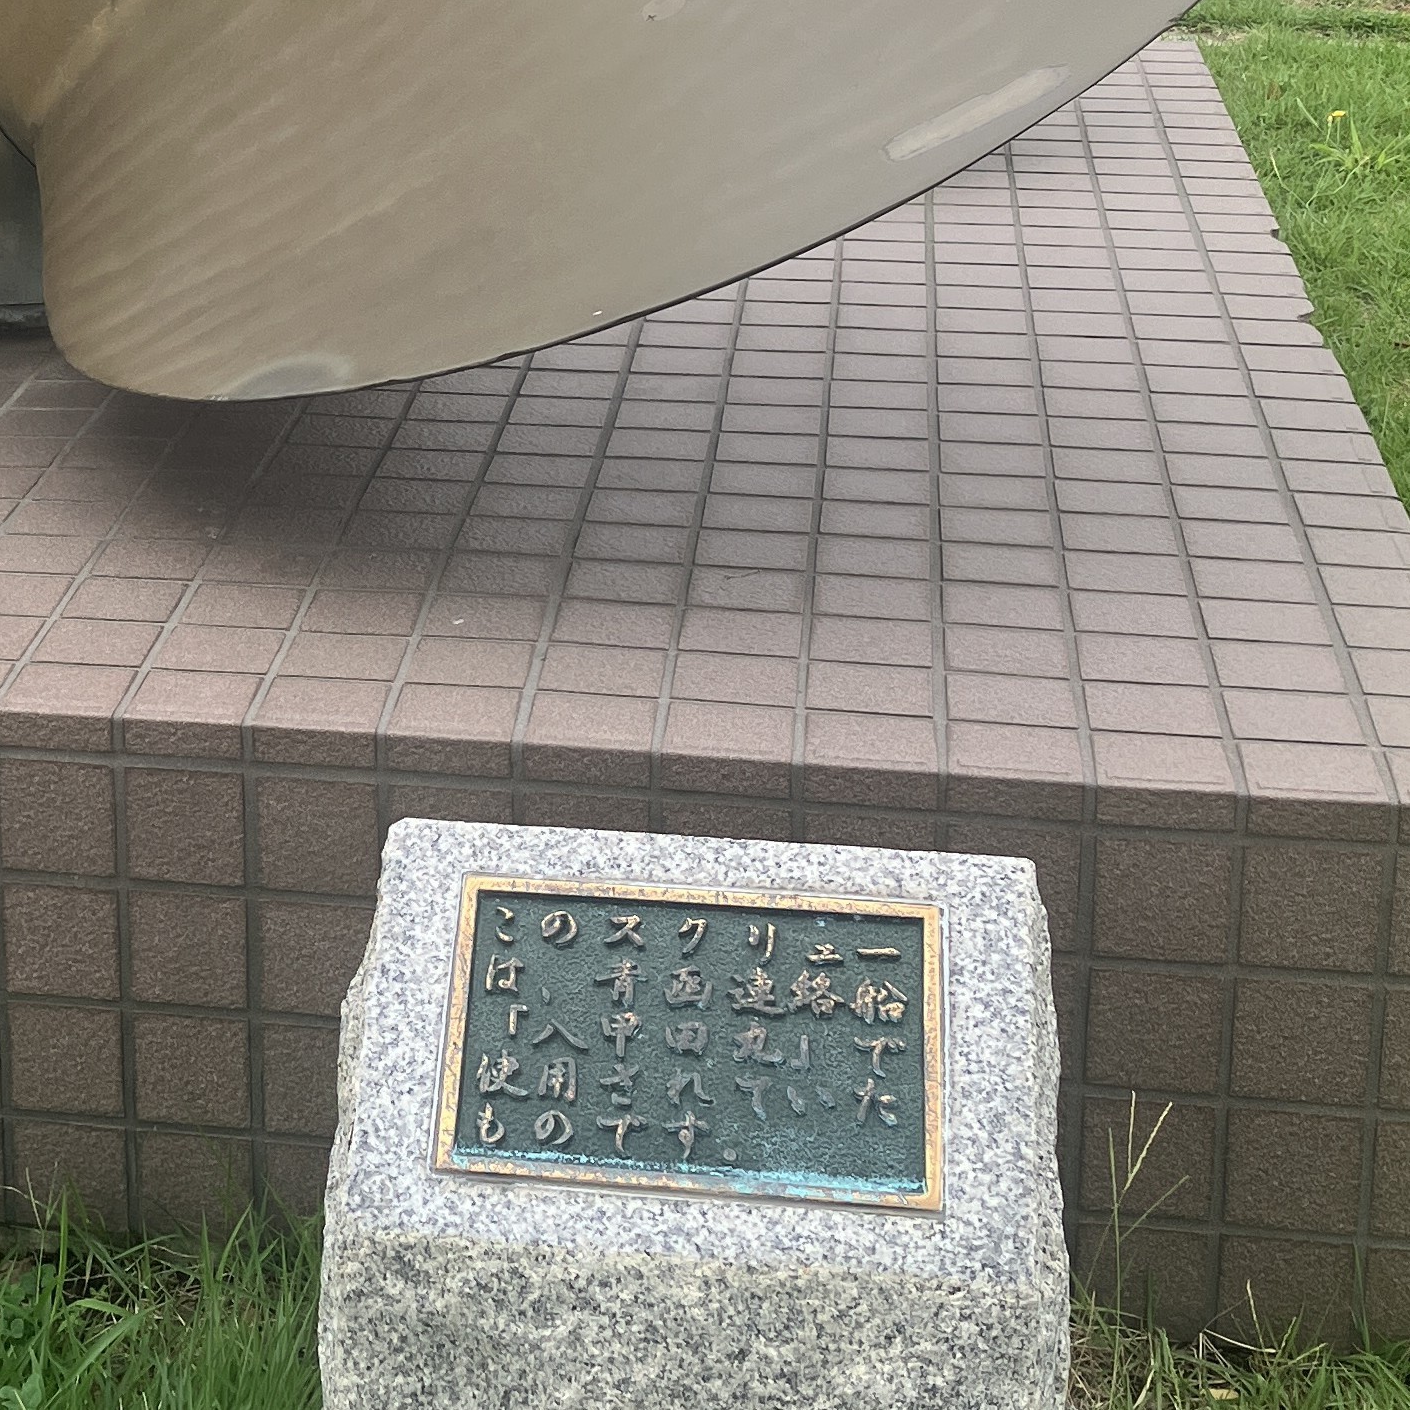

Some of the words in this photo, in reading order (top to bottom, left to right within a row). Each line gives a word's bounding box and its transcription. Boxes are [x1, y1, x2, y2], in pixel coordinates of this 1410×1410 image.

[494, 906, 902, 966] このスクリュー
[485, 952, 908, 1026] は、青函連絡船
[476, 1049, 898, 1127] 使用されていた
[475, 1102, 738, 1163] ものです。
